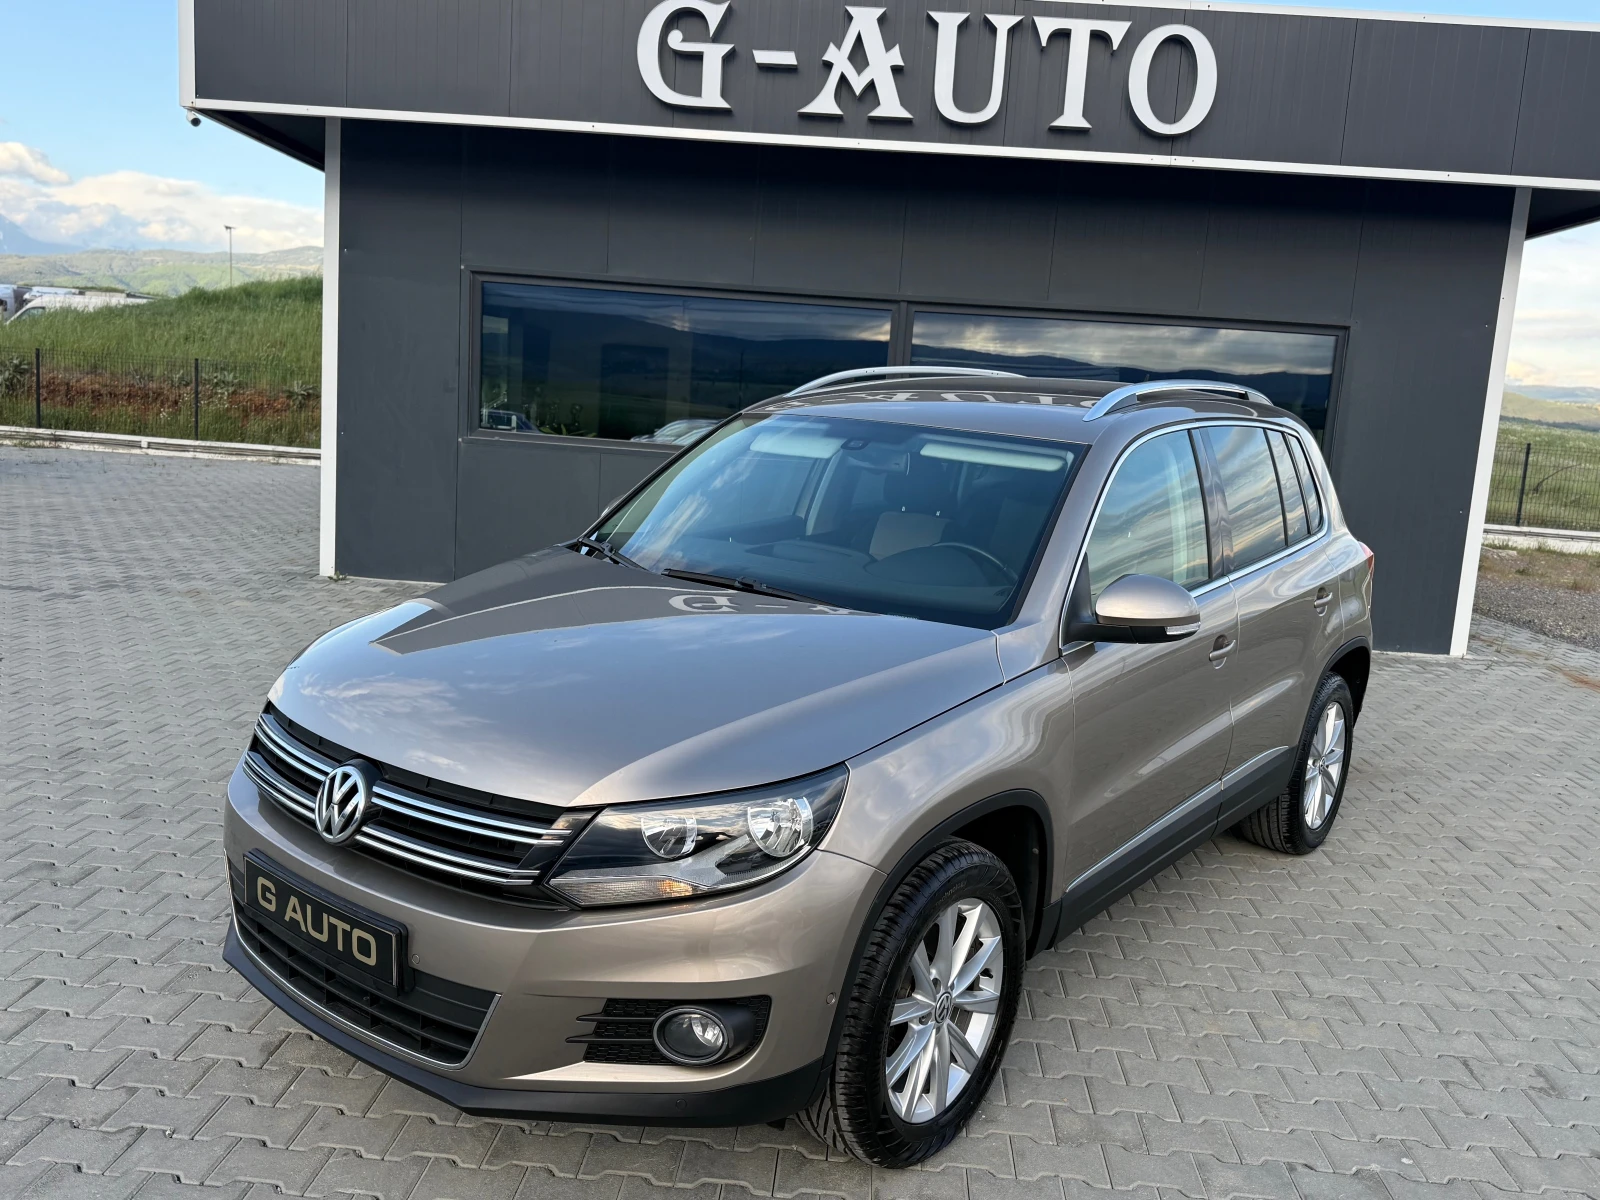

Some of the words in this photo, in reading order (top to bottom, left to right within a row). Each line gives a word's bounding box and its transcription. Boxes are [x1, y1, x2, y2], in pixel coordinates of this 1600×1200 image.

[636, 0, 1218, 137] G-AUTO
[315, 765, 364, 844] VW
[257, 876, 276, 912] G
[284, 895, 377, 966] AUTO
